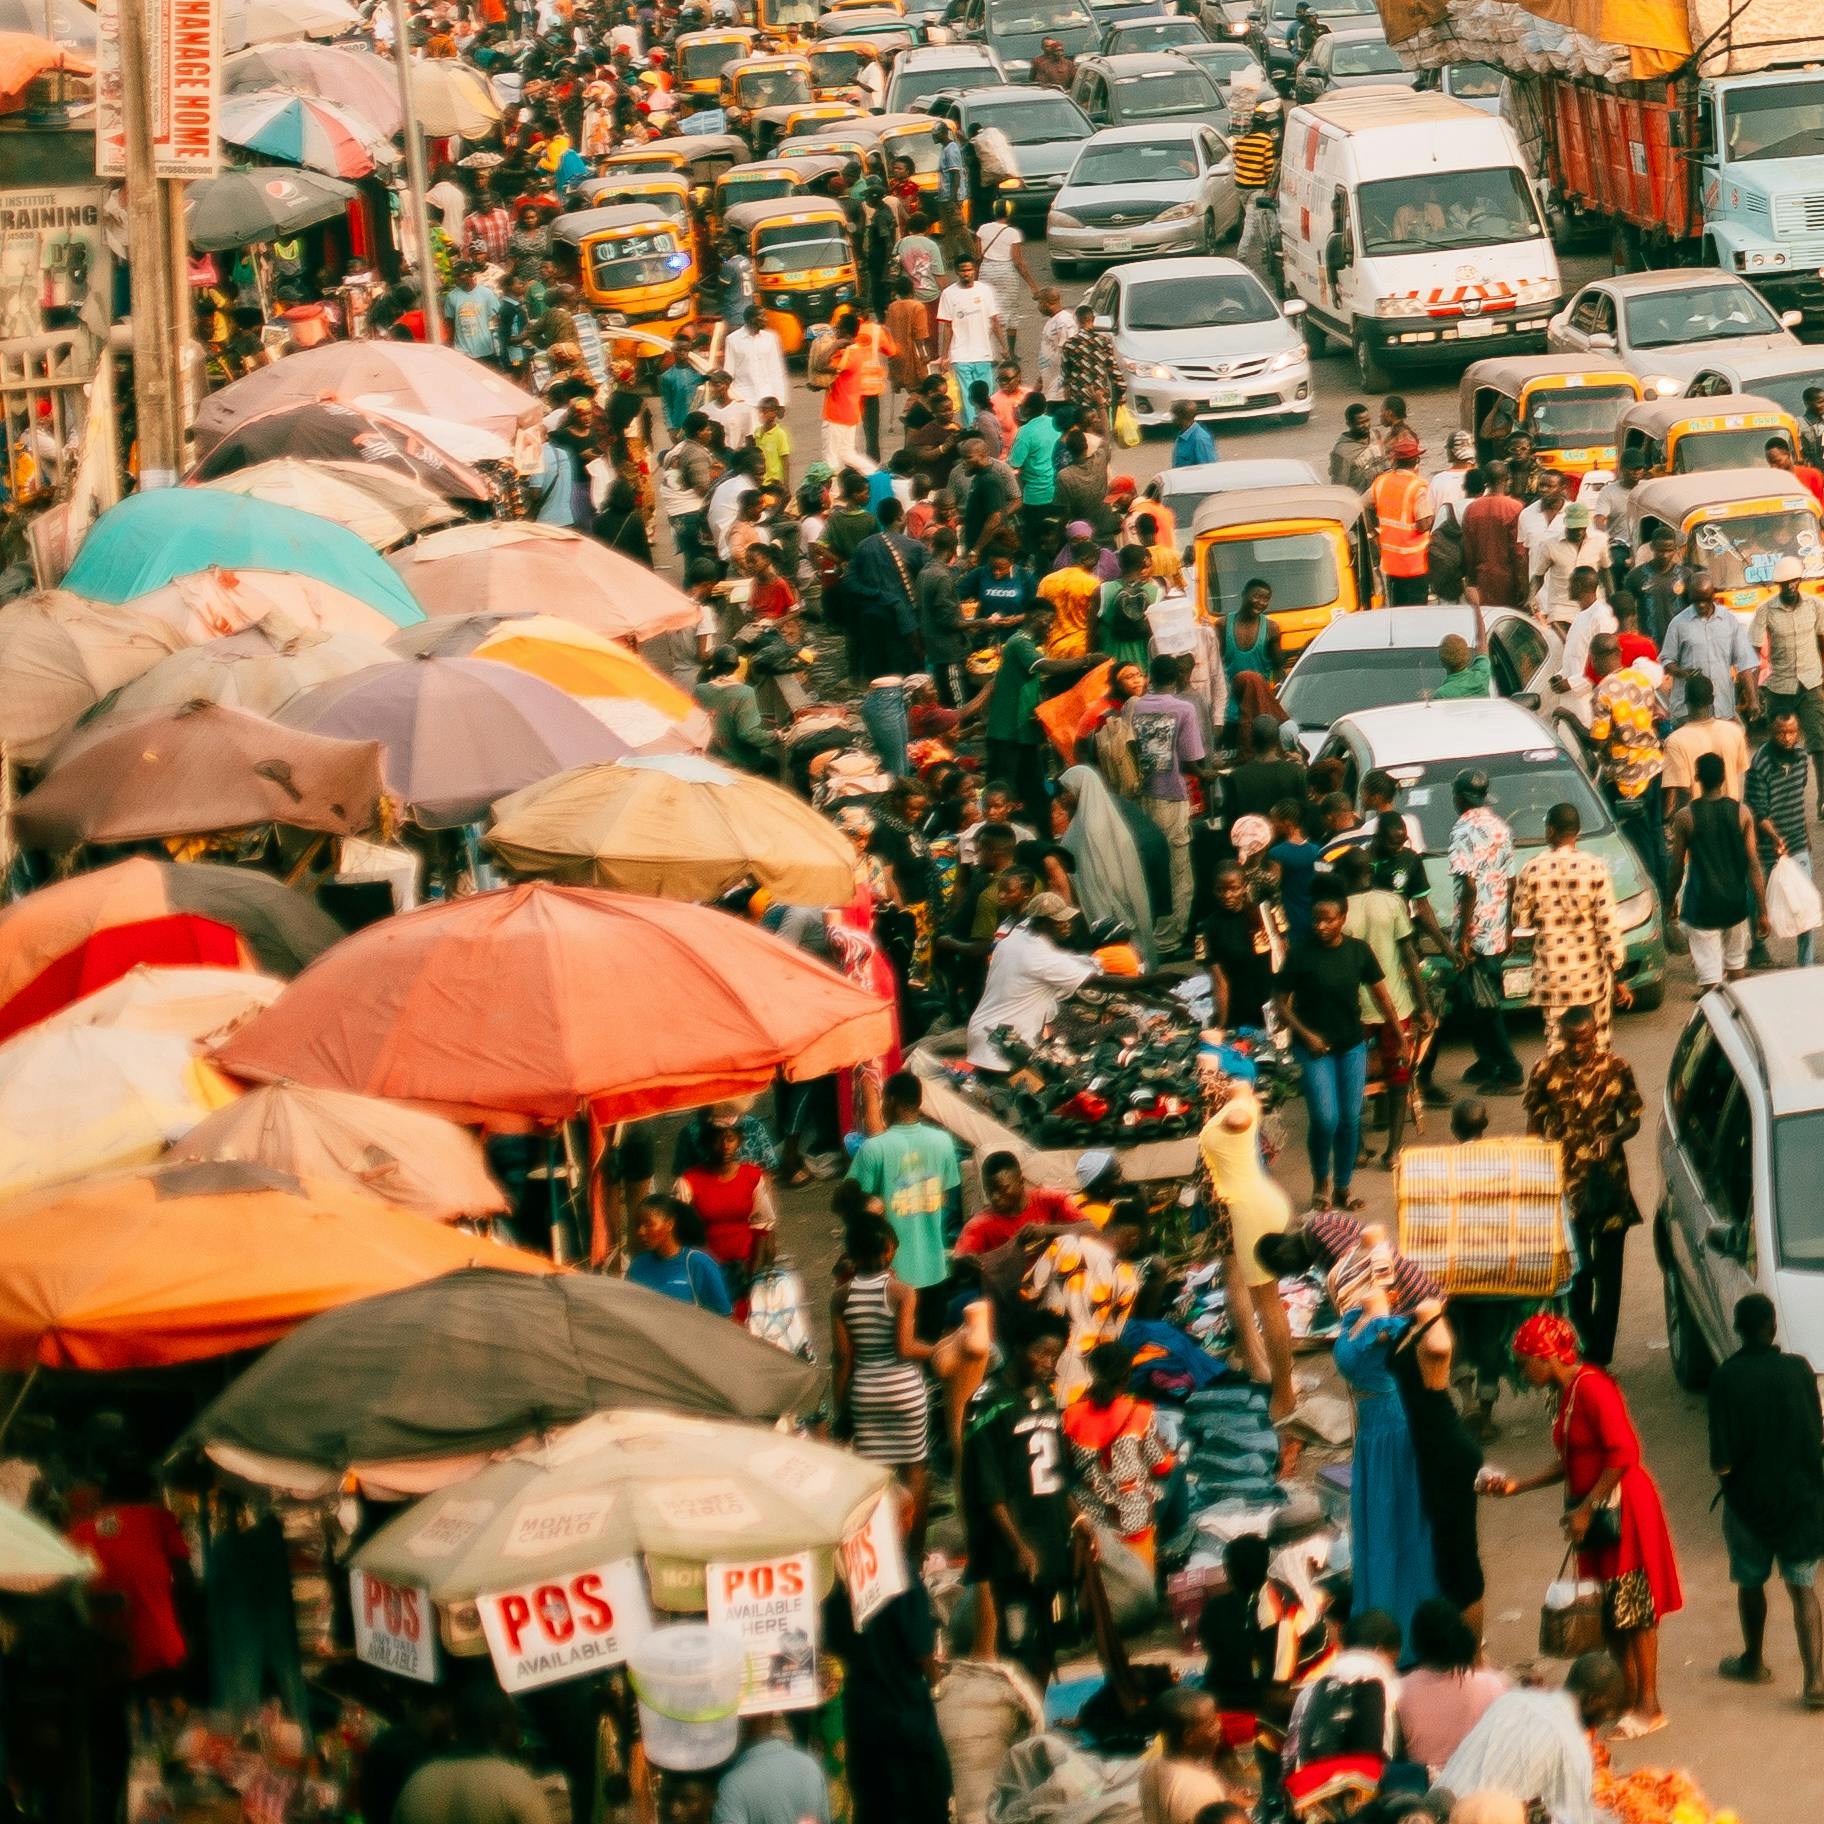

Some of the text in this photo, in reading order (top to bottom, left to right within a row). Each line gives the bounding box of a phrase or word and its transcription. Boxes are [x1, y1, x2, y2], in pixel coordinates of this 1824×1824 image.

[173, 94, 210, 159] HOME
[5, 194, 57, 206] INSTITUTE
[986, 588, 1017, 598] TECNO
[521, 1511, 600, 1532] MONTE
[725, 1561, 806, 1604] POS
[364, 1569, 422, 1644] POS
[497, 1573, 616, 1657] POS
[726, 1597, 803, 1623] AVAILABLE
[742, 1616, 789, 1637] HERE
[516, 1637, 622, 1679] AVAILABLE
